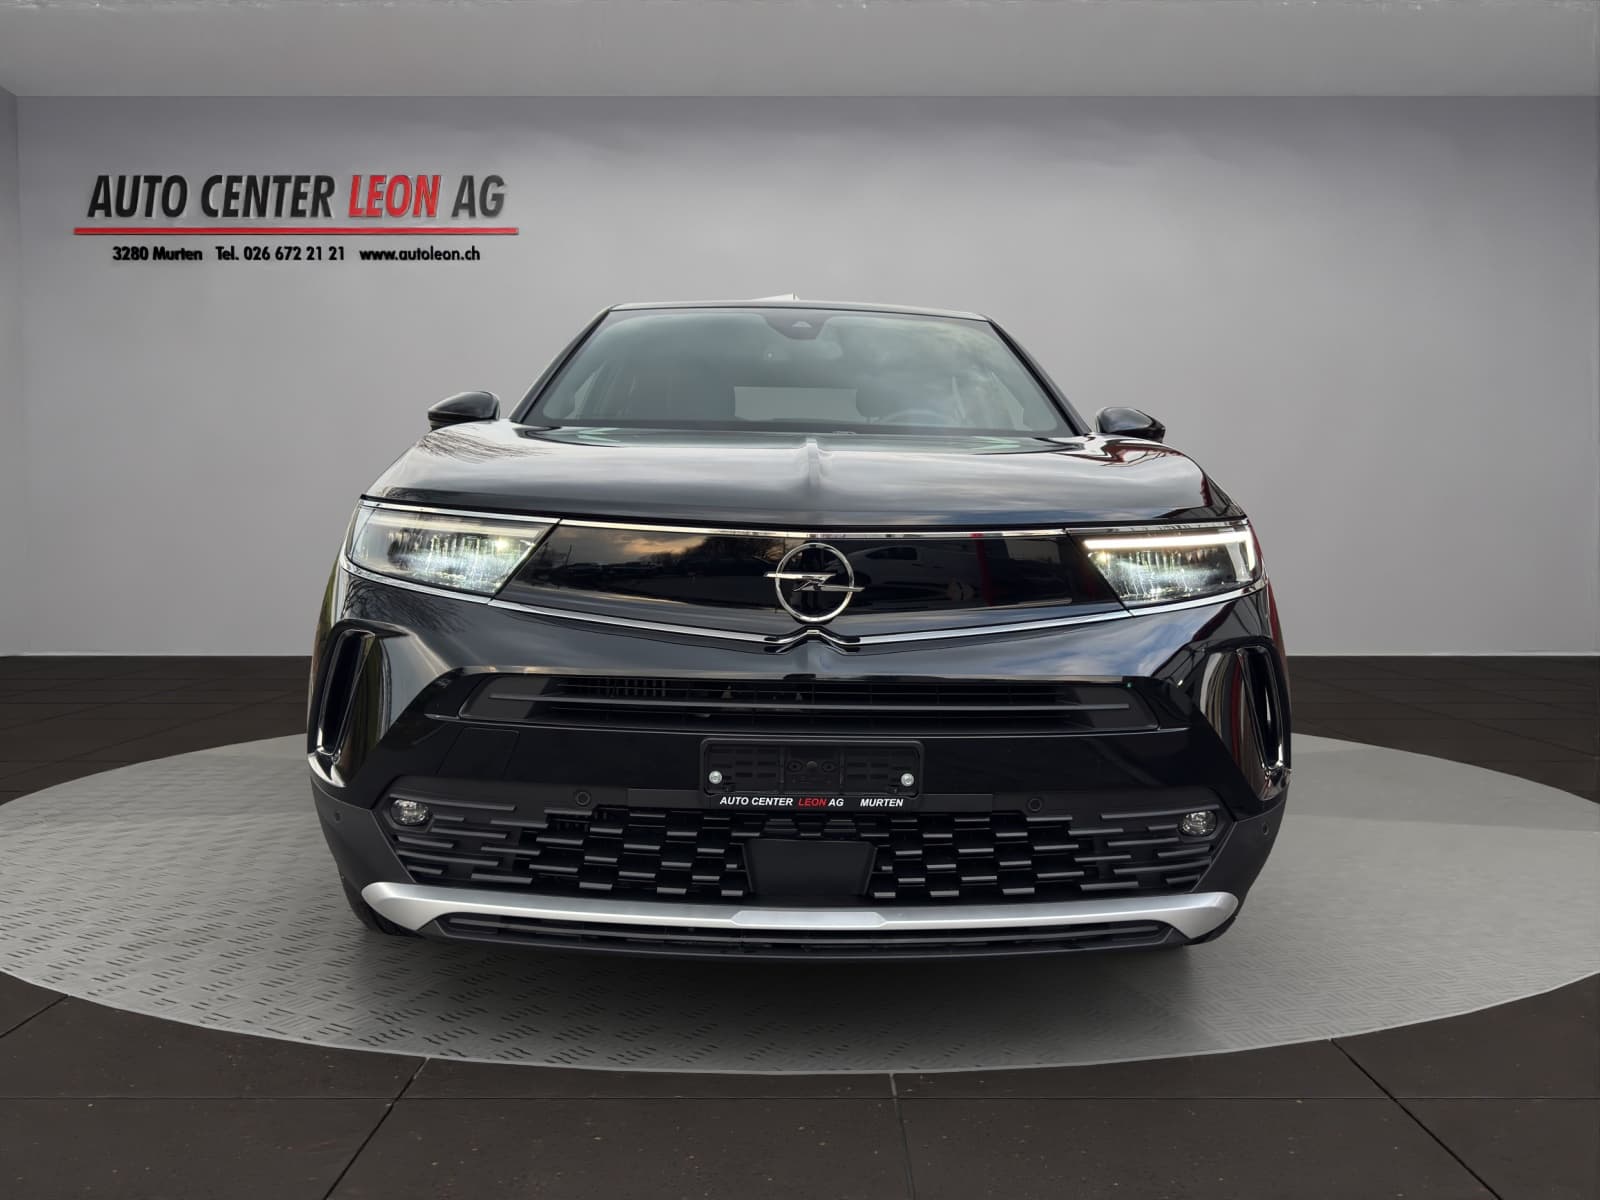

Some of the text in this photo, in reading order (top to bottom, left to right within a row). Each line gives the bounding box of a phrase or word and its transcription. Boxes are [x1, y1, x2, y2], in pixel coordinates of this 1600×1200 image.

[87, 174, 505, 218] AUTO CENTER LEON AG
[112, 245, 481, 261] 3280 Murten Tel. 026 672 21 21 www.autoleon.ch
[719, 796, 904, 808] AUTO CENTER LEON AG MURTEN
